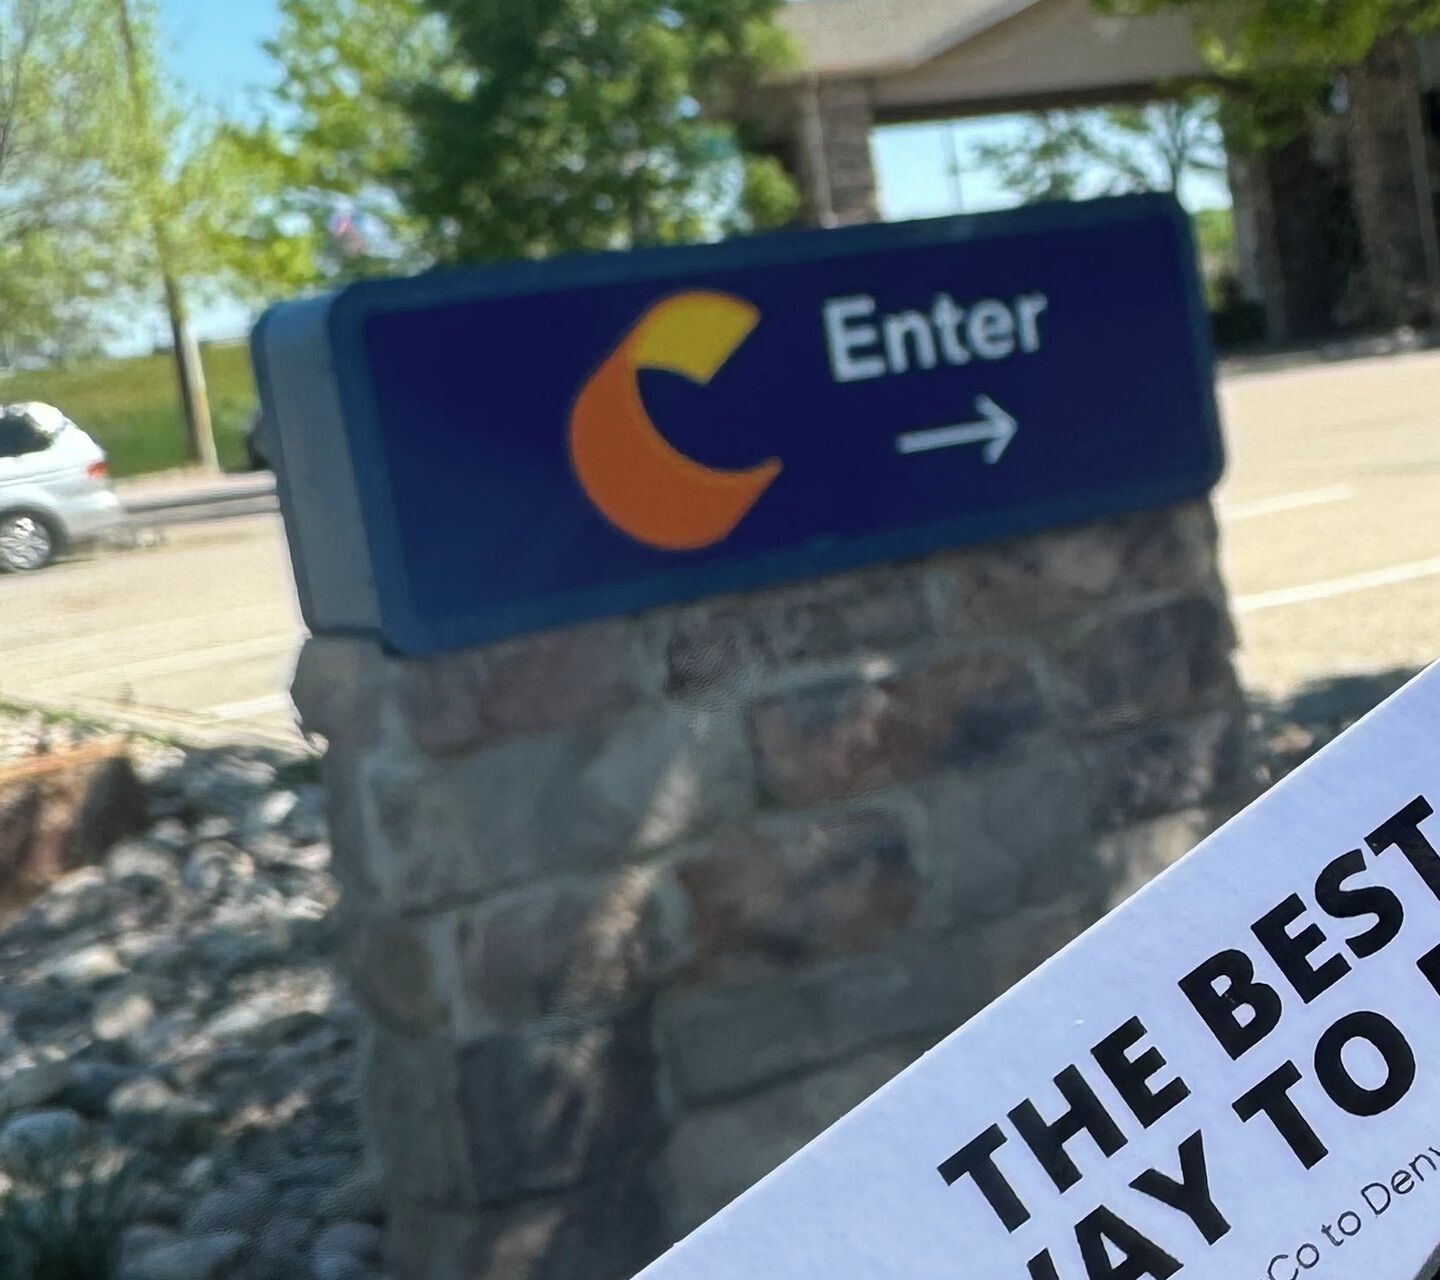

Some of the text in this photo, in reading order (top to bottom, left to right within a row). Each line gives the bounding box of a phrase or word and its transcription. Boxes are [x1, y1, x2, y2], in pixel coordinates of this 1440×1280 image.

[823, 292, 1049, 383] Enter
[937, 1016, 1191, 1234] THE
[1232, 1010, 1417, 1170] TO
[1321, 1209, 1363, 1248] to
